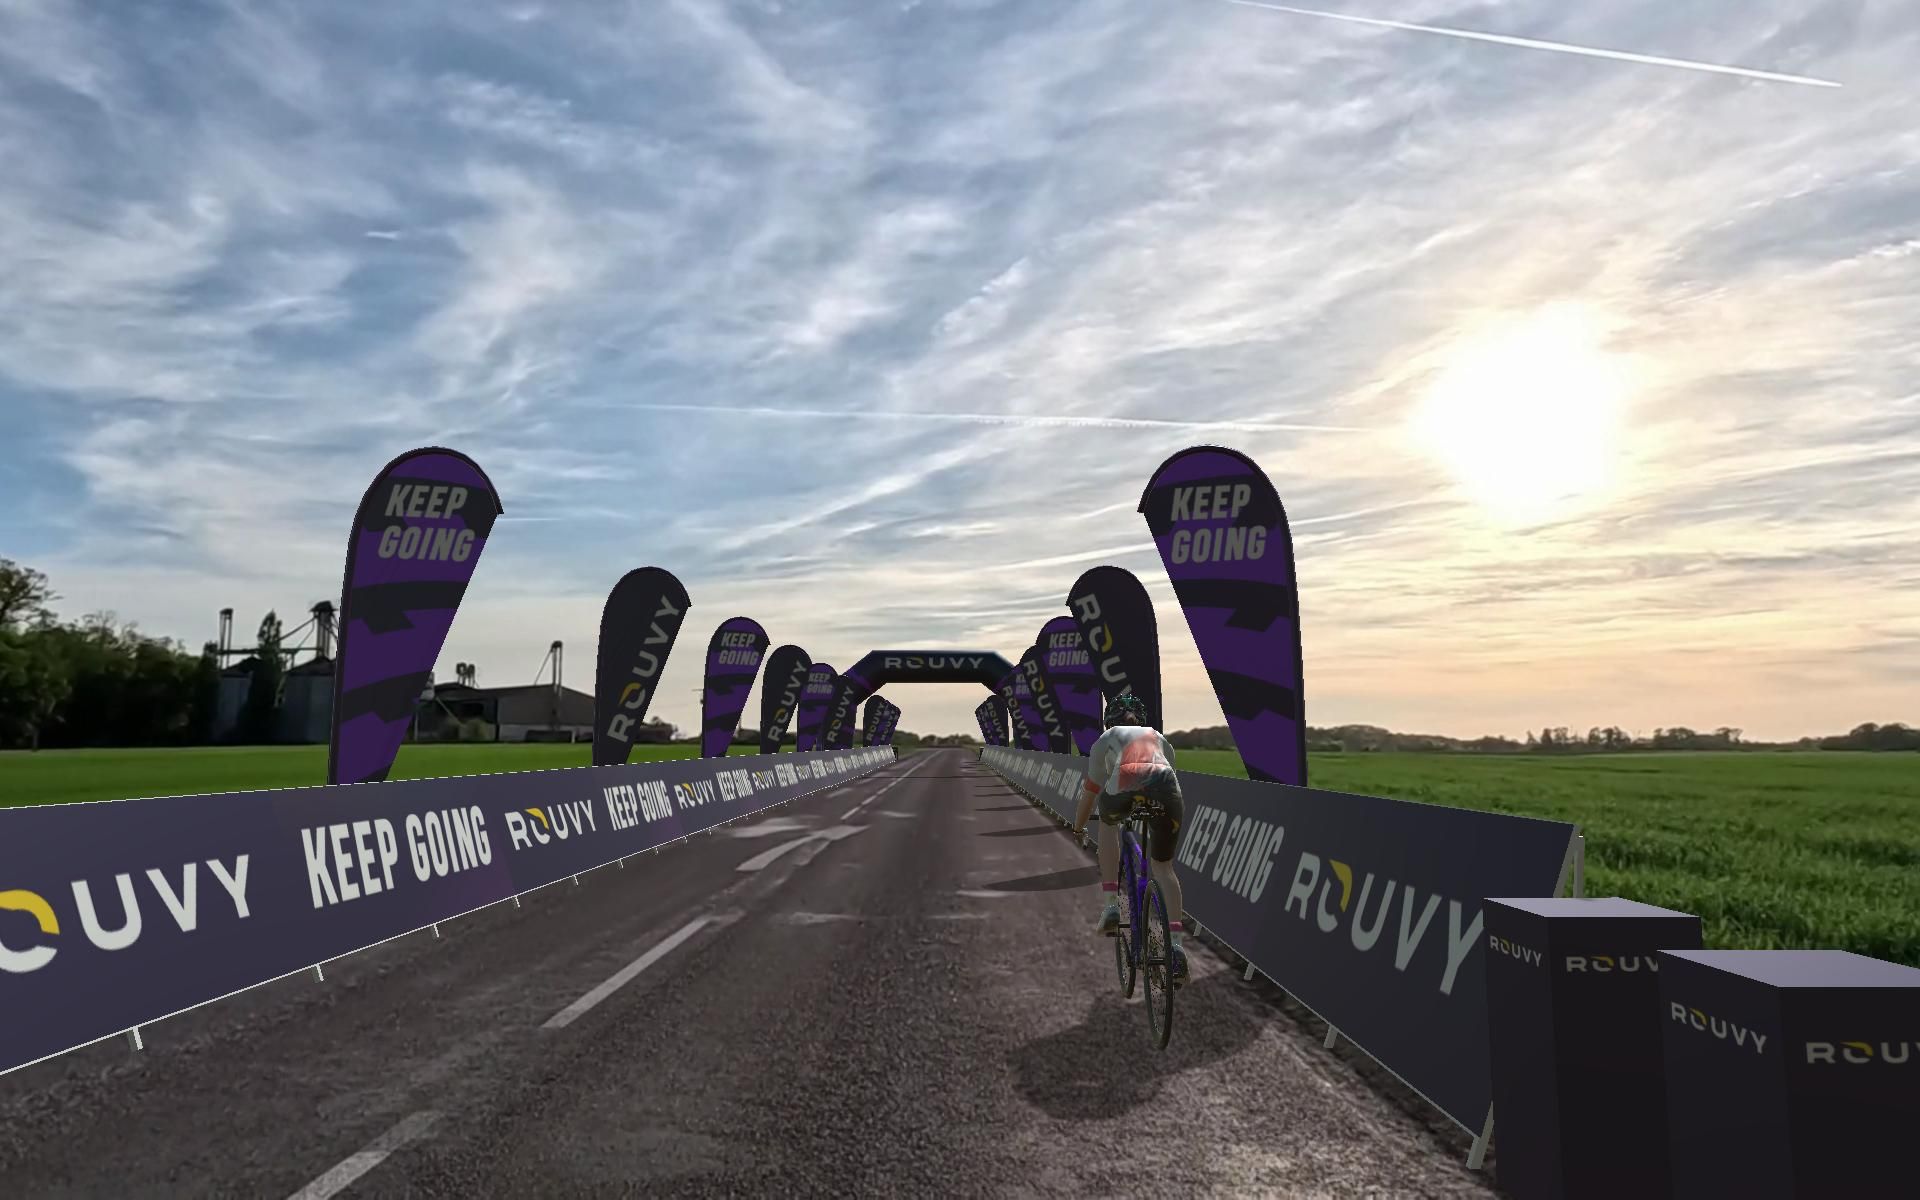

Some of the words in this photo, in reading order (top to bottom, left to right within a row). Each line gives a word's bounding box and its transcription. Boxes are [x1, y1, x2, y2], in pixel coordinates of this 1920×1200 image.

[384, 484, 468, 519] KEEP
[1170, 484, 1251, 522] KEEP
[377, 525, 476, 562] GOING
[1170, 525, 1267, 565] GOING
[718, 650, 759, 666] GOING
[720, 632, 756, 648] KEEP
[1049, 649, 1089, 667] GOING
[1074, 593, 1132, 698] ROU
[606, 594, 680, 743] ROUVY
[808, 672, 831, 683] KEEP
[884, 656, 984, 669] ROUVY
[767, 659, 807, 742] ROUVY
[807, 684, 833, 695] GOING
[1023, 659, 1064, 739] ROUVY
[826, 685, 854, 743] ROUVY
[1003, 686, 1031, 739] ROUVY
[0, 854, 250, 974] OUVY
[301, 818, 399, 909] KEEP
[405, 805, 492, 882] GOING
[504, 800, 597, 851] ROUVY
[603, 785, 639, 831] KEEP
[636, 779, 673, 823] GOING
[673, 779, 716, 810] ROUVY
[715, 771, 737, 802] KEEP
[1177, 804, 1228, 873] KEEP
[1211, 814, 1285, 903] GOING
[1284, 851, 1484, 996] ROUVY
[1490, 935, 1541, 967] ROUVY
[1566, 955, 1659, 972] ROUV
[1671, 1001, 1767, 1054] ROUVY
[1806, 1041, 1920, 1064] ROU
